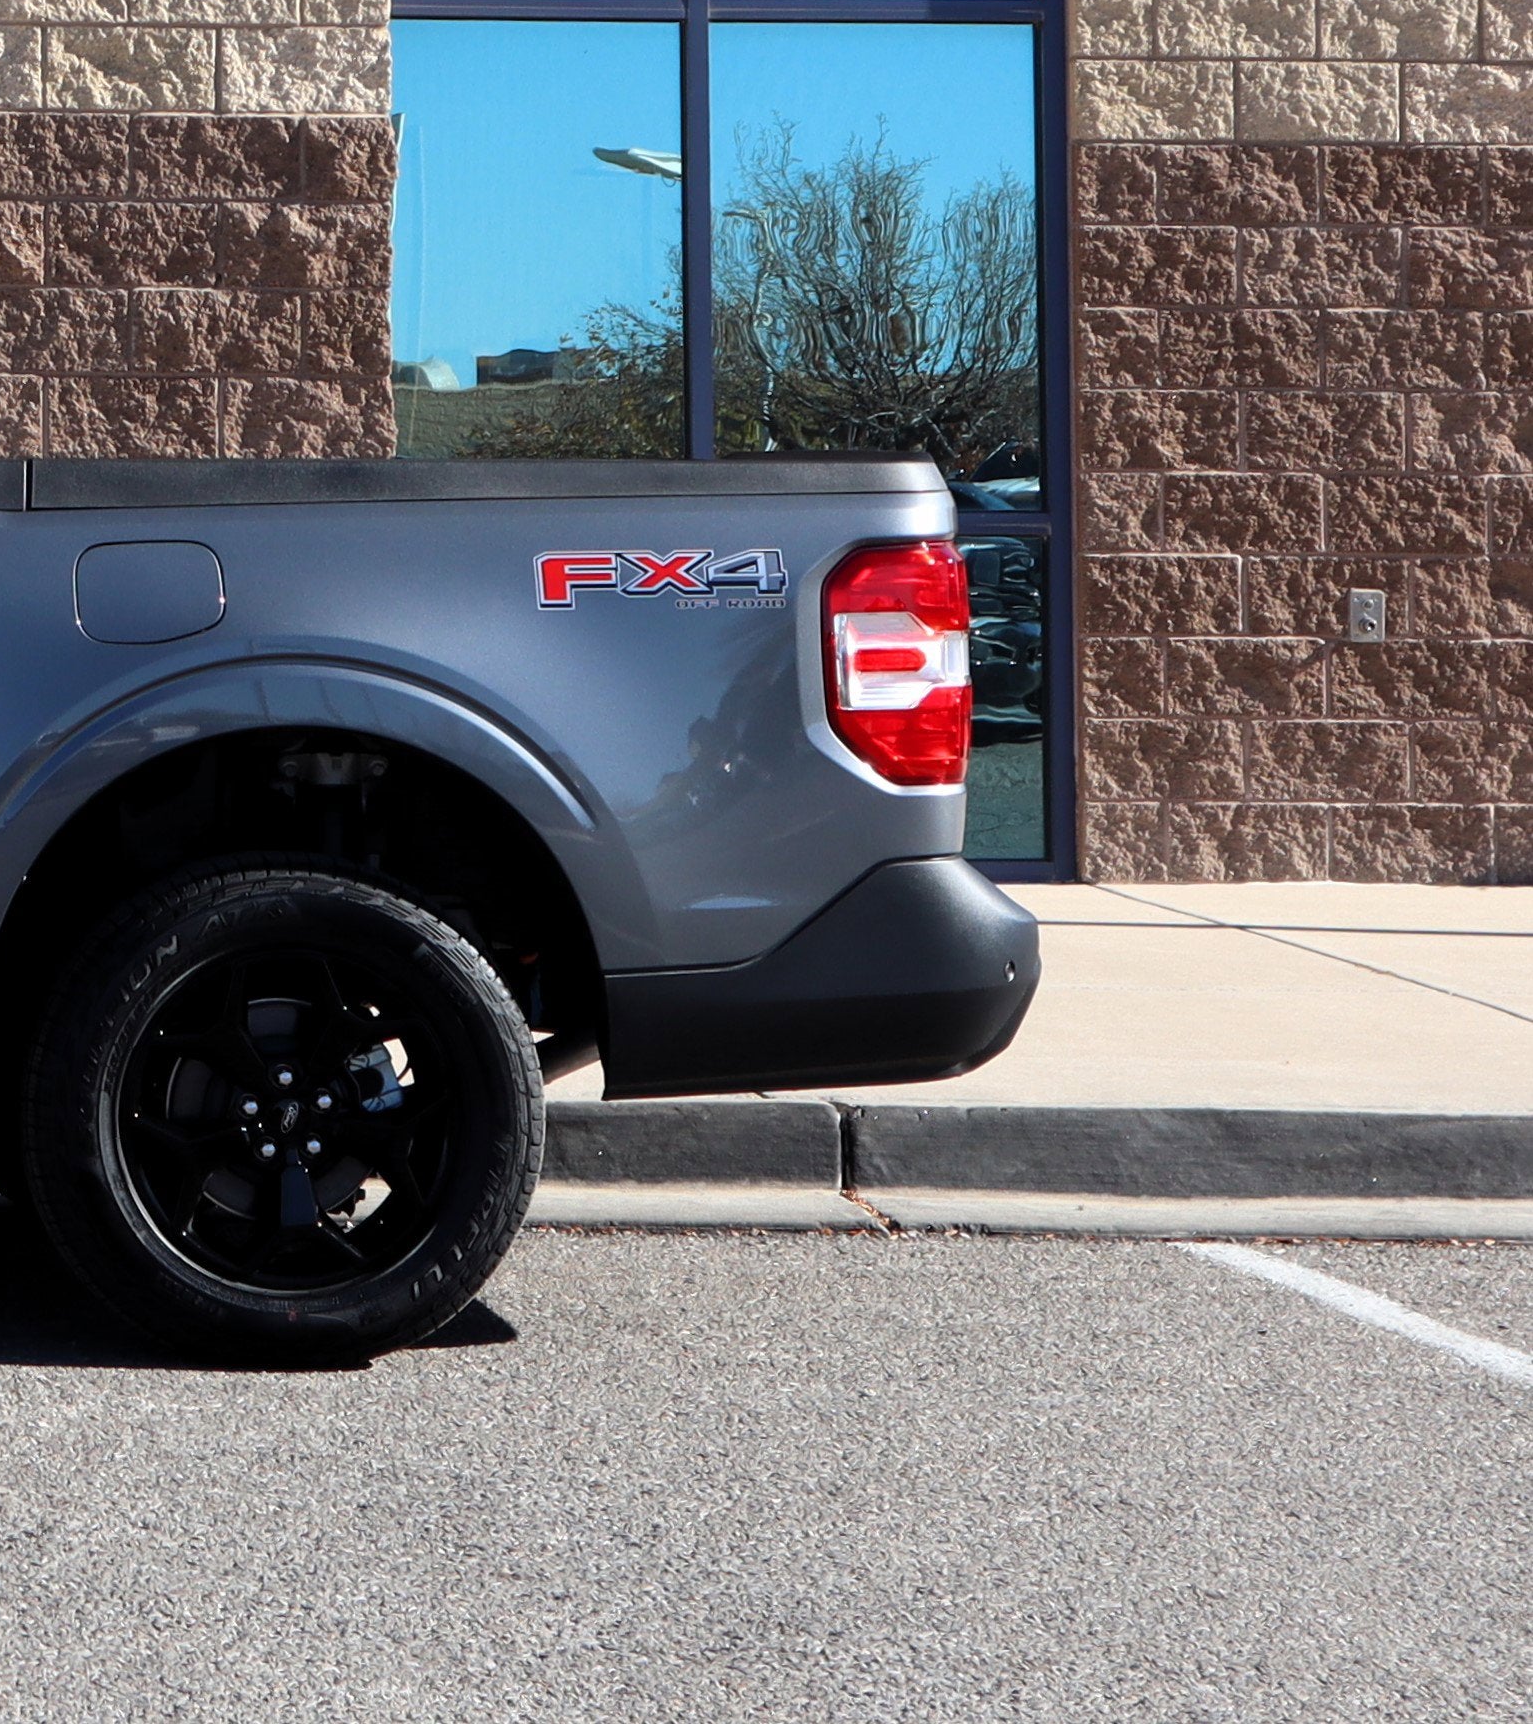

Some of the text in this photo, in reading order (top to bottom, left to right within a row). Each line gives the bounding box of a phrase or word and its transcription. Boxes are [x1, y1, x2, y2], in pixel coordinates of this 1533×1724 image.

[533, 547, 788, 611] FX4
[675, 598, 786, 609] OFF ROAD
